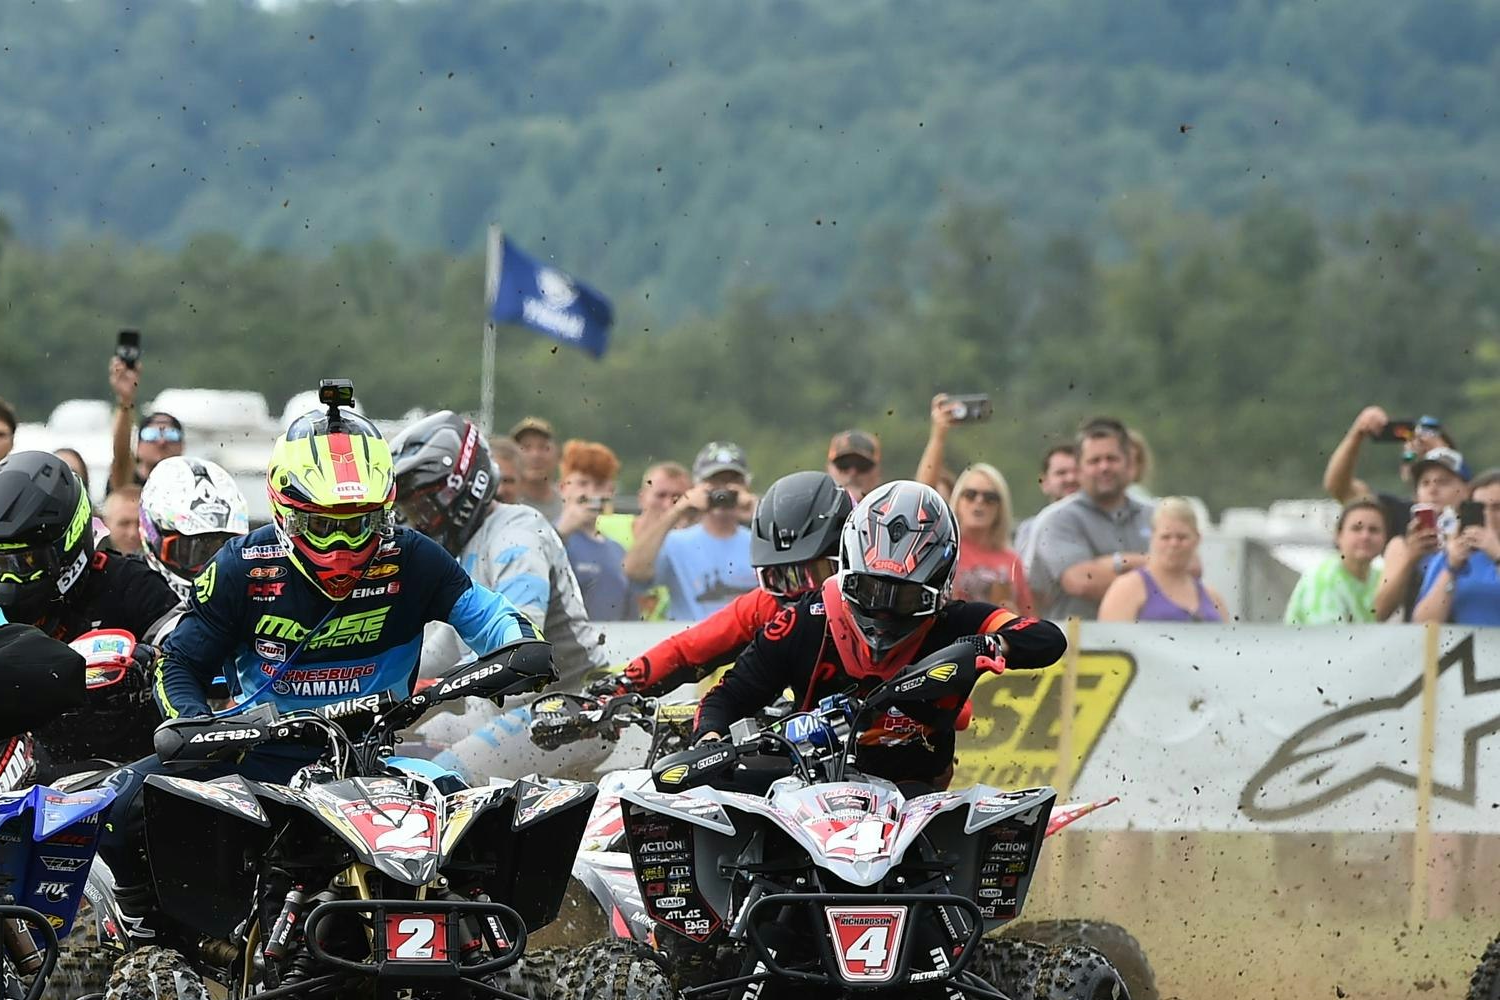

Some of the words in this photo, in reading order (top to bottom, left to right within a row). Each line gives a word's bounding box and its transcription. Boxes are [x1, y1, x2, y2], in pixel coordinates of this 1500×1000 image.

[874, 560, 905, 573] SHOEI
[352, 586, 385, 599] Elka
[255, 605, 392, 642] MOOSE
[303, 629, 382, 651] RACING
[291, 679, 360, 696] YAMAHA
[439, 663, 503, 696] ACERBIS
[189, 729, 261, 743] ACERBIS
[825, 820, 886, 855] 4
[640, 840, 683, 853] ACTION
[991, 843, 1027, 852] ACTION
[36, 882, 70, 901] FOX
[658, 898, 685, 906] EVANS
[665, 909, 701, 920] ATLAS
[841, 917, 892, 926] RICHARDSON
[279, 922, 292, 945] Elka
[396, 918, 436, 957] 2
[846, 927, 889, 966] 4
